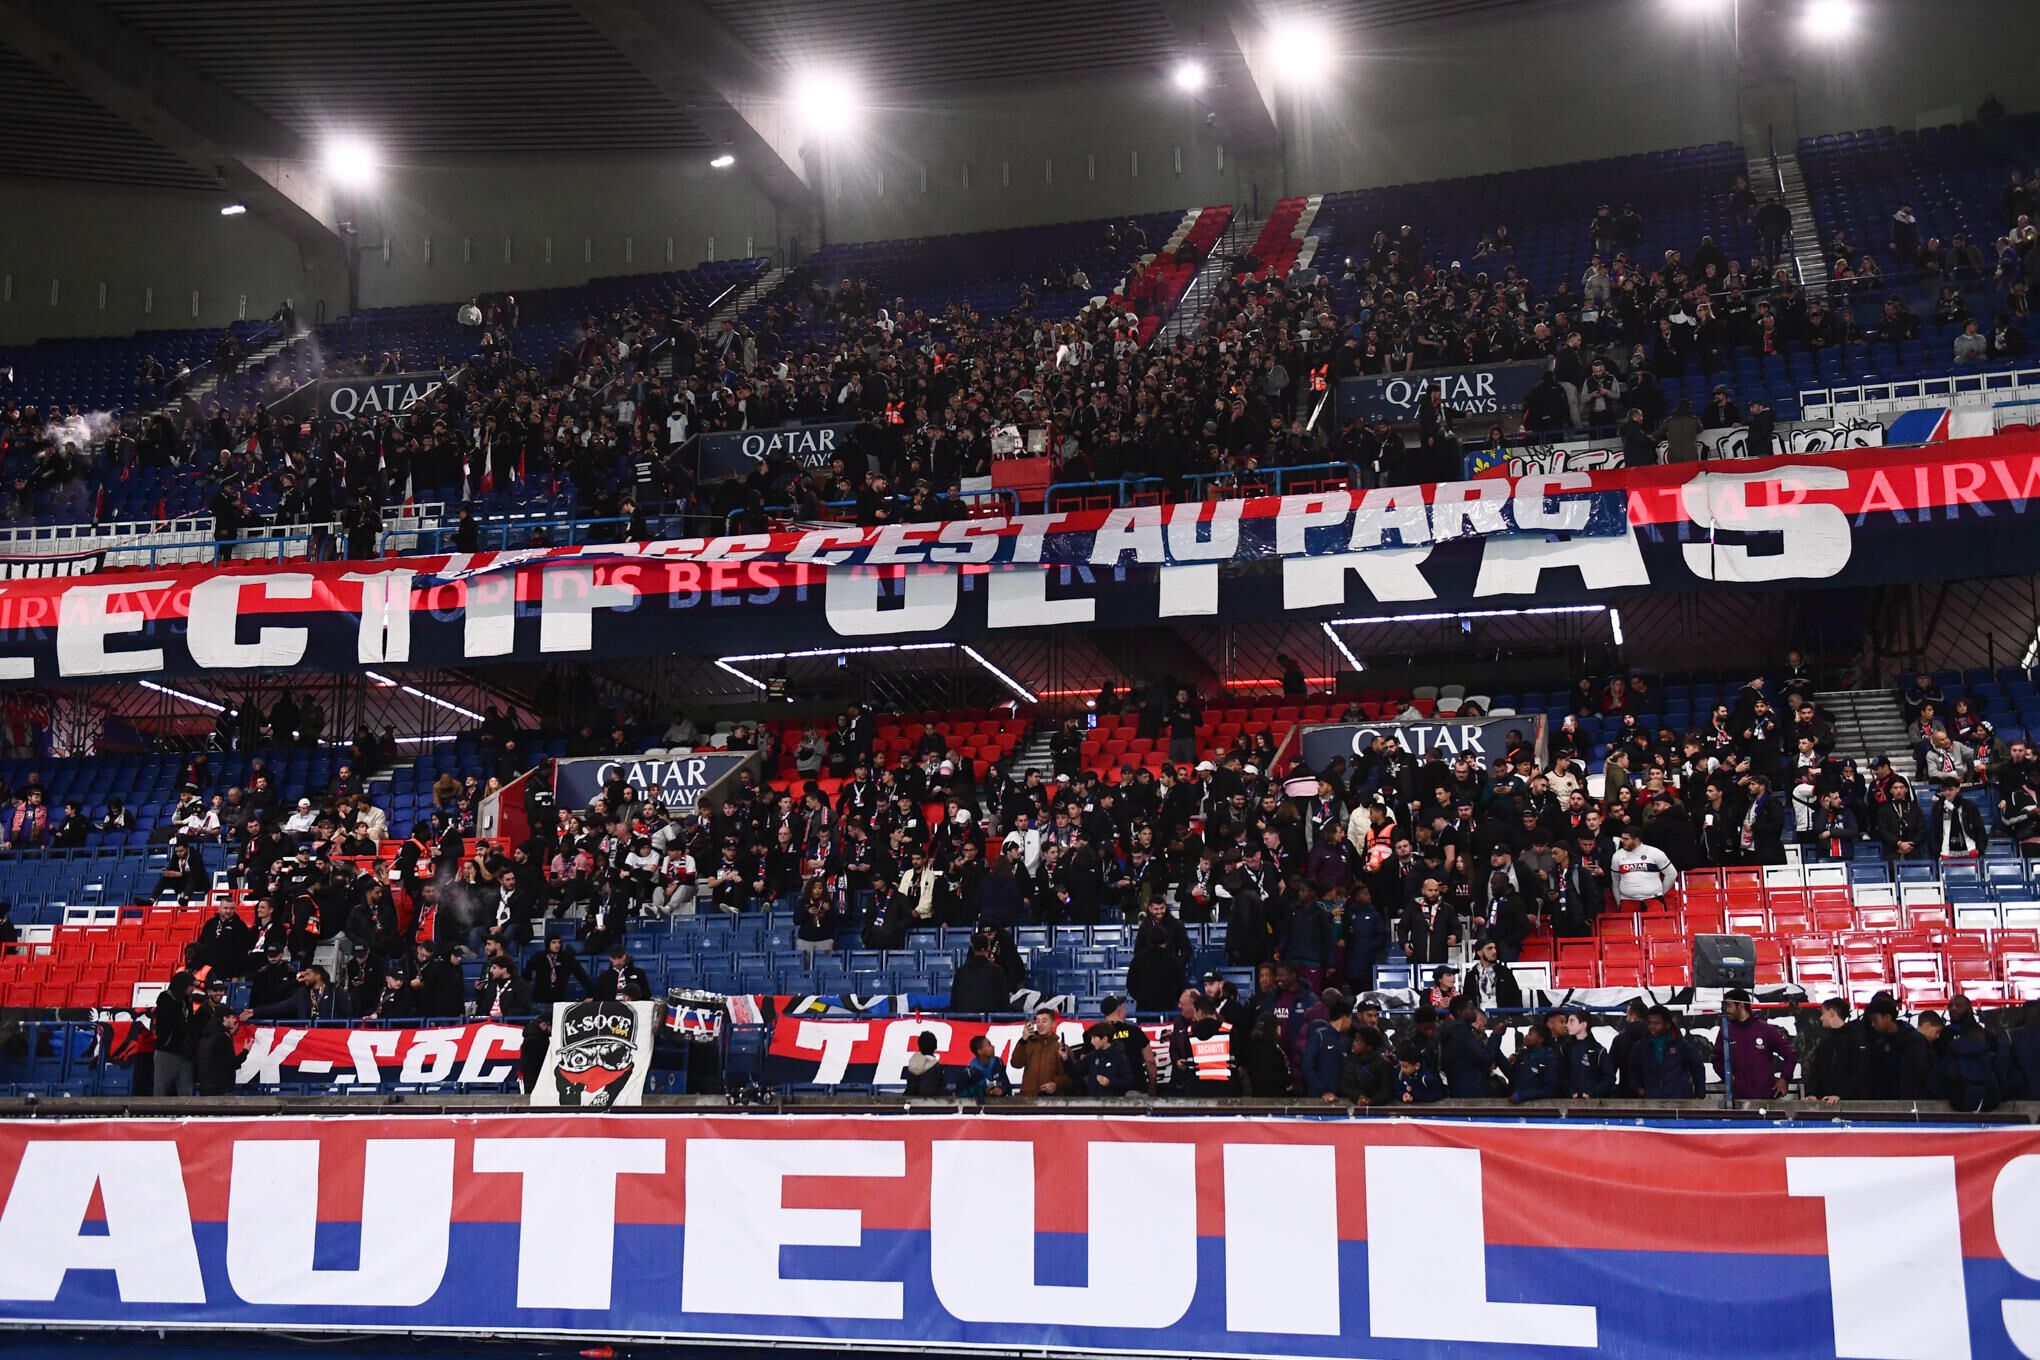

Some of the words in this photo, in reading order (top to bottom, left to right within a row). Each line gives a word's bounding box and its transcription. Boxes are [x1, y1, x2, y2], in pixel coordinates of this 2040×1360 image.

[1385, 373, 1496, 408] QATAR
[742, 429, 835, 460] QATAR
[1089, 499, 1243, 564] AU
[1276, 474, 1593, 557] PARC
[668, 561, 810, 611] BEST
[1352, 725, 1486, 758] QATAR
[596, 759, 707, 790] QATAR
[565, 1014, 632, 1036] K-SOCE
[0, 1138, 1598, 1348] AUTEUIL
